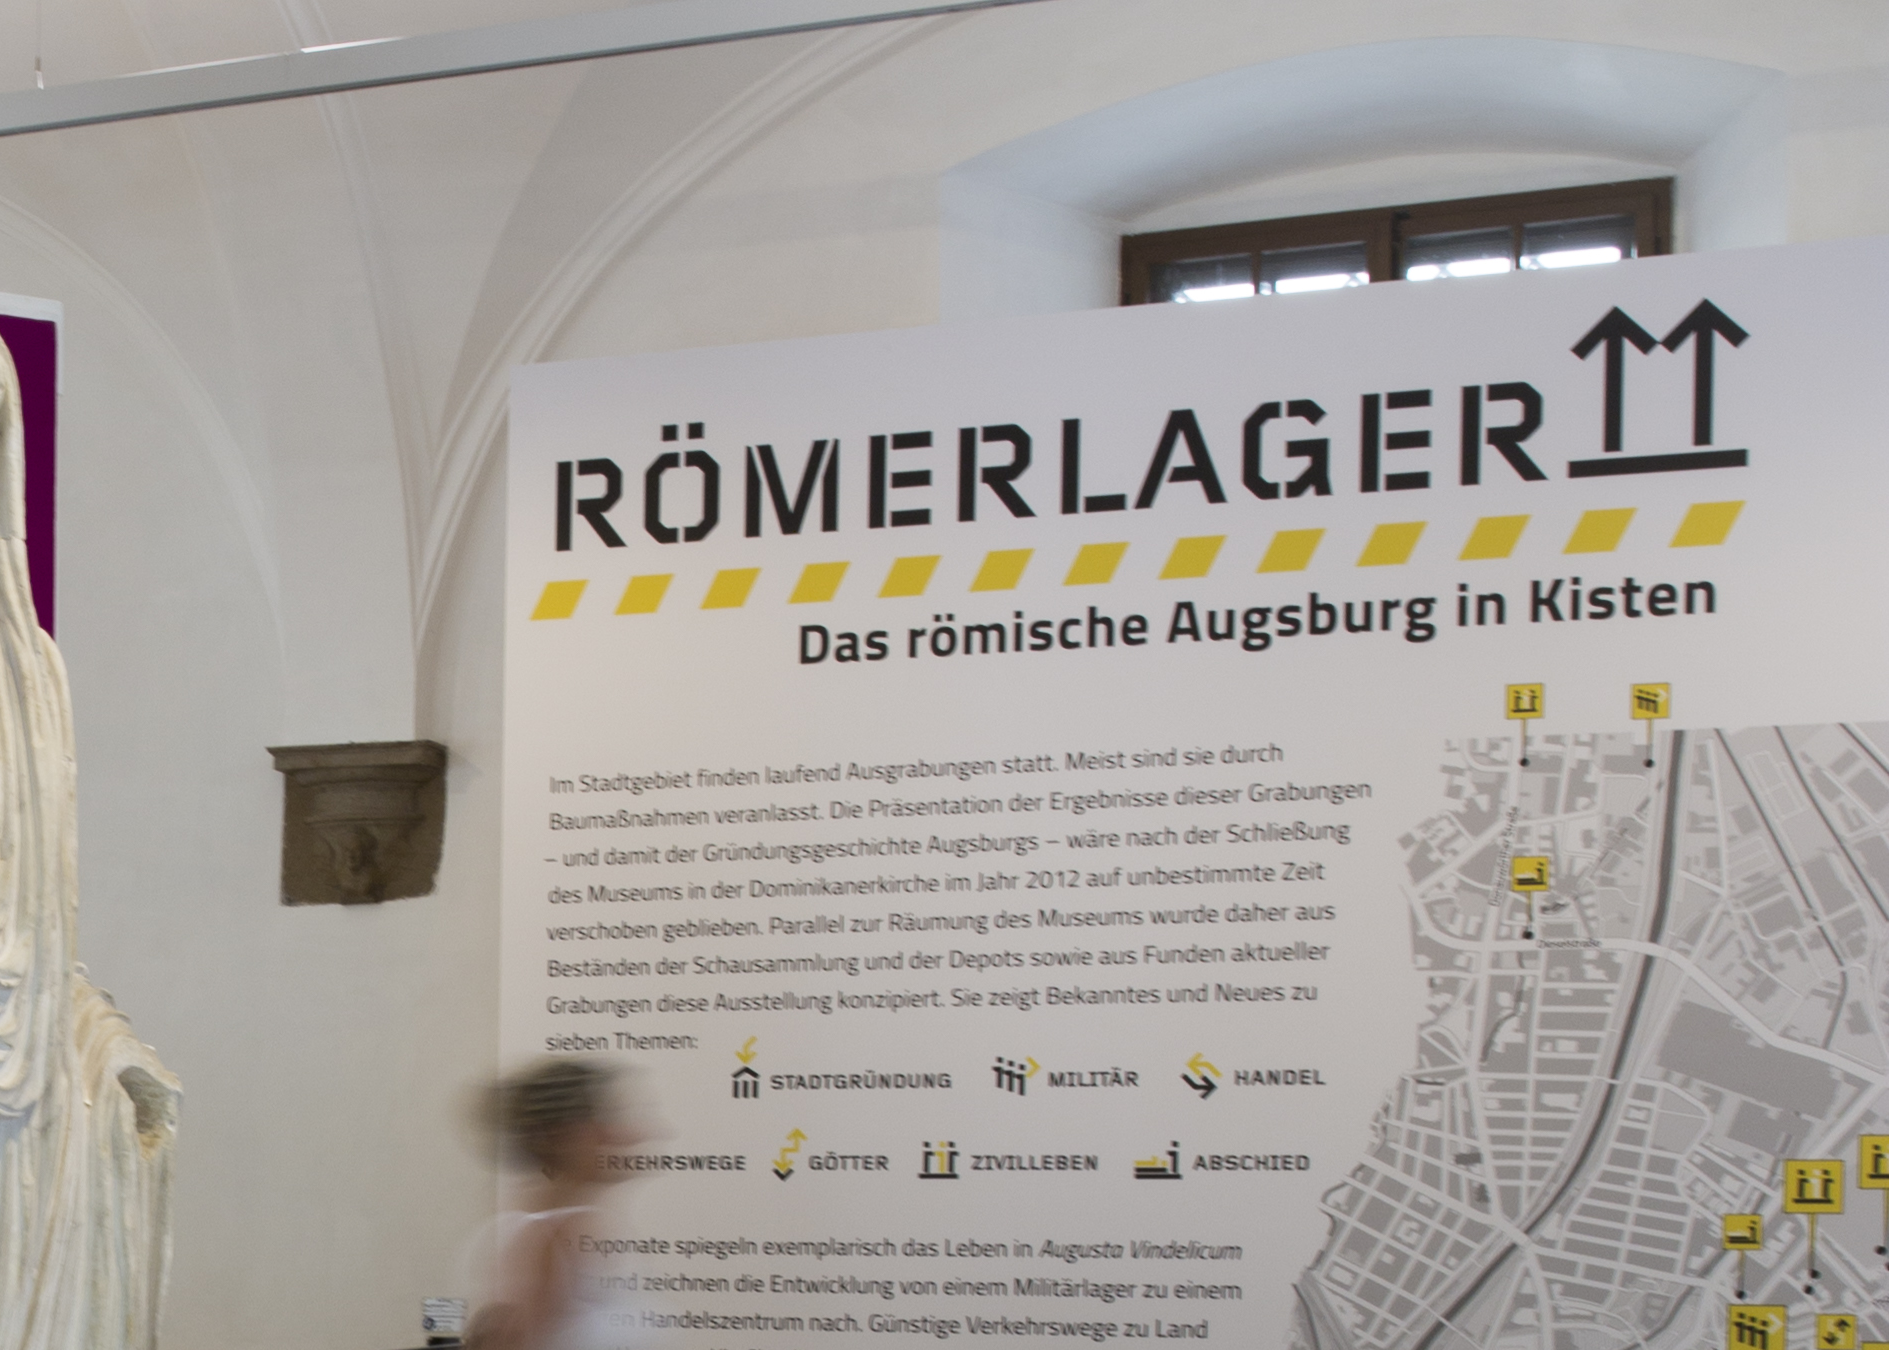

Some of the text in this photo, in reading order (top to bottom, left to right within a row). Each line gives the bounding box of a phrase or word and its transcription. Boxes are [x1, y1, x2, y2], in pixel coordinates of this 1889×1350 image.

[555, 381, 1547, 552] RÖMERLAGER
[800, 576, 1715, 665] Das römische Augsburg in Kisten
[550, 742, 1284, 796] Im Stadtgebiet finden laufend Ausgrabungen statt. Meist sind sie durch
[549, 782, 1372, 831] Baumaßnahmen veranlasst. Die Präsentation der Ergebnisse dieser Grabungen
[562, 820, 1351, 868] und damit der Gründungsgeschichte Augsburgs wäre nach der Schließung
[547, 861, 1325, 905] des Museums in der Dominikanerkirche im Jahr 2012 auf unbestimmte Zeit
[546, 902, 1336, 944] verschoben geblieben. Parallel zur Räumung des Museums wurde daher aus
[547, 941, 1330, 978] Beständen der Schausammlung und der Depots sowie aus Funden aktueller
[546, 982, 1318, 1019] Grabungen diese Ausstellung konzipiert. Sie zeigt Bekanntes und Neues zu
[545, 1031, 698, 1051] sieben Themen:
[770, 1069, 952, 1091] STADTGRÜNDUNG
[1048, 1066, 1139, 1088] MILITÄR
[1234, 1068, 1326, 1086] HANDEL
[595, 1154, 747, 1172] ERKEHRSWEGE
[808, 1151, 889, 1171] GÖTTER
[971, 1154, 1099, 1171] ZIVILLEBEN
[1193, 1154, 1310, 1172] ABSCHIED
[578, 1233, 671, 1259] Exponate
[674, 1236, 758, 1261] spiegeln
[762, 1237, 897, 1261] exemplarisch
[901, 1237, 940, 1258] das
[944, 1238, 1009, 1258] Leben
[1013, 1240, 1035, 1259] in
[1038, 1238, 1125, 1265] Augusta
[1130, 1240, 1243, 1261] Vindelicum
[642, 1273, 730, 1292] zeichnen
[733, 1274, 768, 1294] die
[769, 1273, 895, 1301] Entwicklung
[898, 1280, 938, 1296] von
[942, 1277, 1008, 1297] einem
[1013, 1277, 1138, 1304] Militärlager
[1142, 1283, 1169, 1300] zu
[1173, 1280, 1243, 1301] einem
[640, 1310, 804, 1332] Handelszentrum
[808, 1313, 863, 1333] nach.
[867, 1313, 962, 1340] Günstige
[965, 1315, 1119, 1343] Verkehrswege
[1123, 1322, 1150, 1339] zu
[1155, 1319, 1209, 1340] Land
